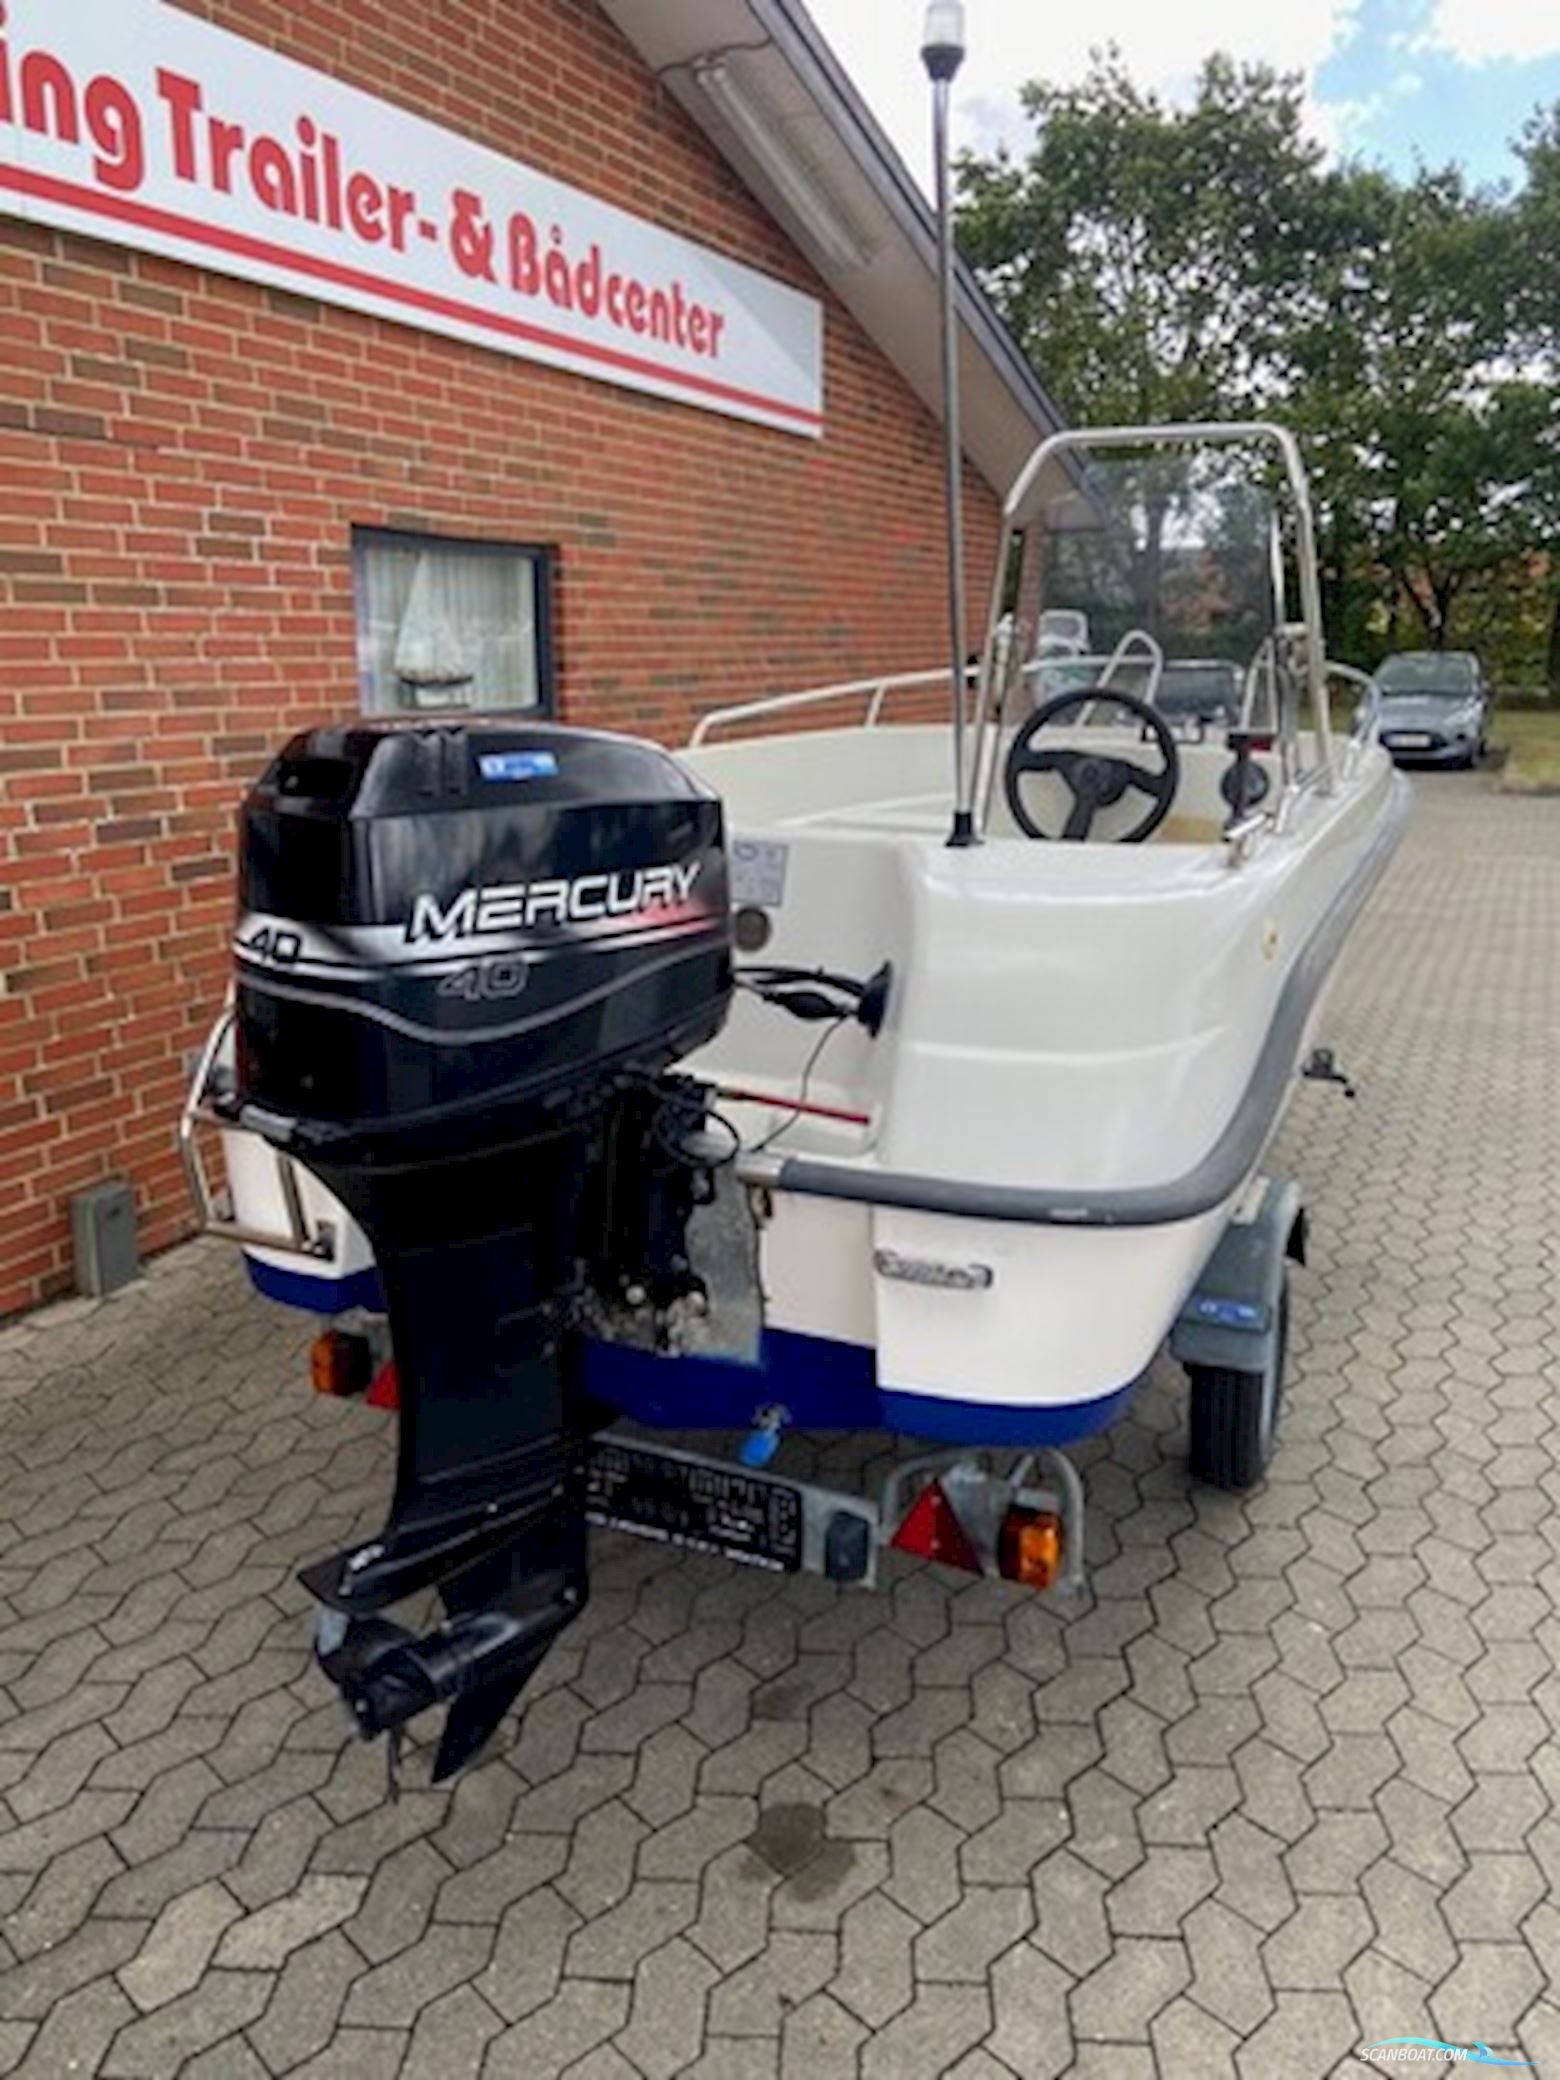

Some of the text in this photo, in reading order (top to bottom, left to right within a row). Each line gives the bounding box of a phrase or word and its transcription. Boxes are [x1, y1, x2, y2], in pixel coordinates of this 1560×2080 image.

[450, 189, 498, 284] &
[508, 213, 724, 358] Bådcenter
[405, 863, 699, 942] MERCURY
[248, 927, 302, 962] 40
[436, 957, 529, 1000] 40
